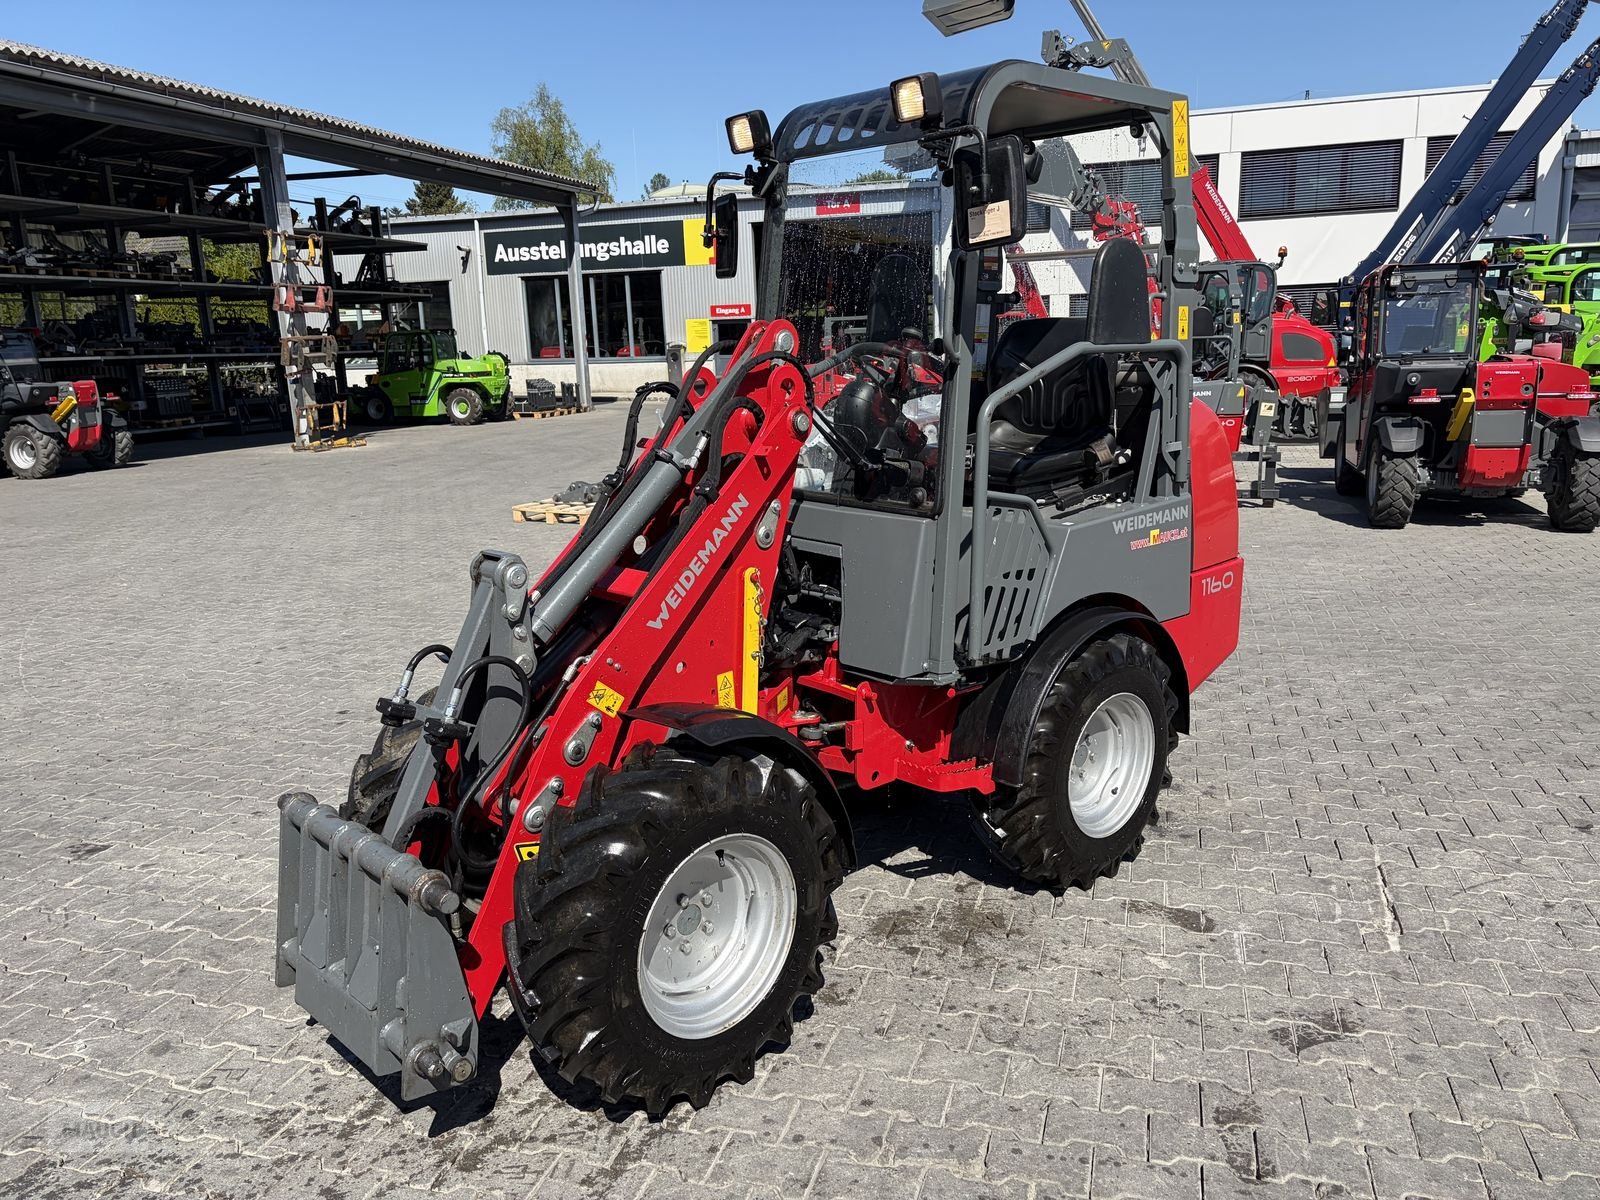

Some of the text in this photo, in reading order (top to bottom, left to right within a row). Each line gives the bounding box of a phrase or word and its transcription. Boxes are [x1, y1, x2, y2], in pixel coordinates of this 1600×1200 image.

[825, 198, 851, 209] Tor A
[969, 207, 996, 218] Stockger
[1204, 180, 1233, 225] WEIDEMANN
[494, 234, 670, 263] Ausstelngshalle
[1393, 234, 1417, 263] 50.26
[1439, 245, 1456, 264] 0.17
[715, 307, 740, 315] Eingang
[1112, 505, 1189, 535] WEIDEMANN
[646, 493, 750, 630] WEIDEMANN
[1201, 571, 1234, 597] 1160
